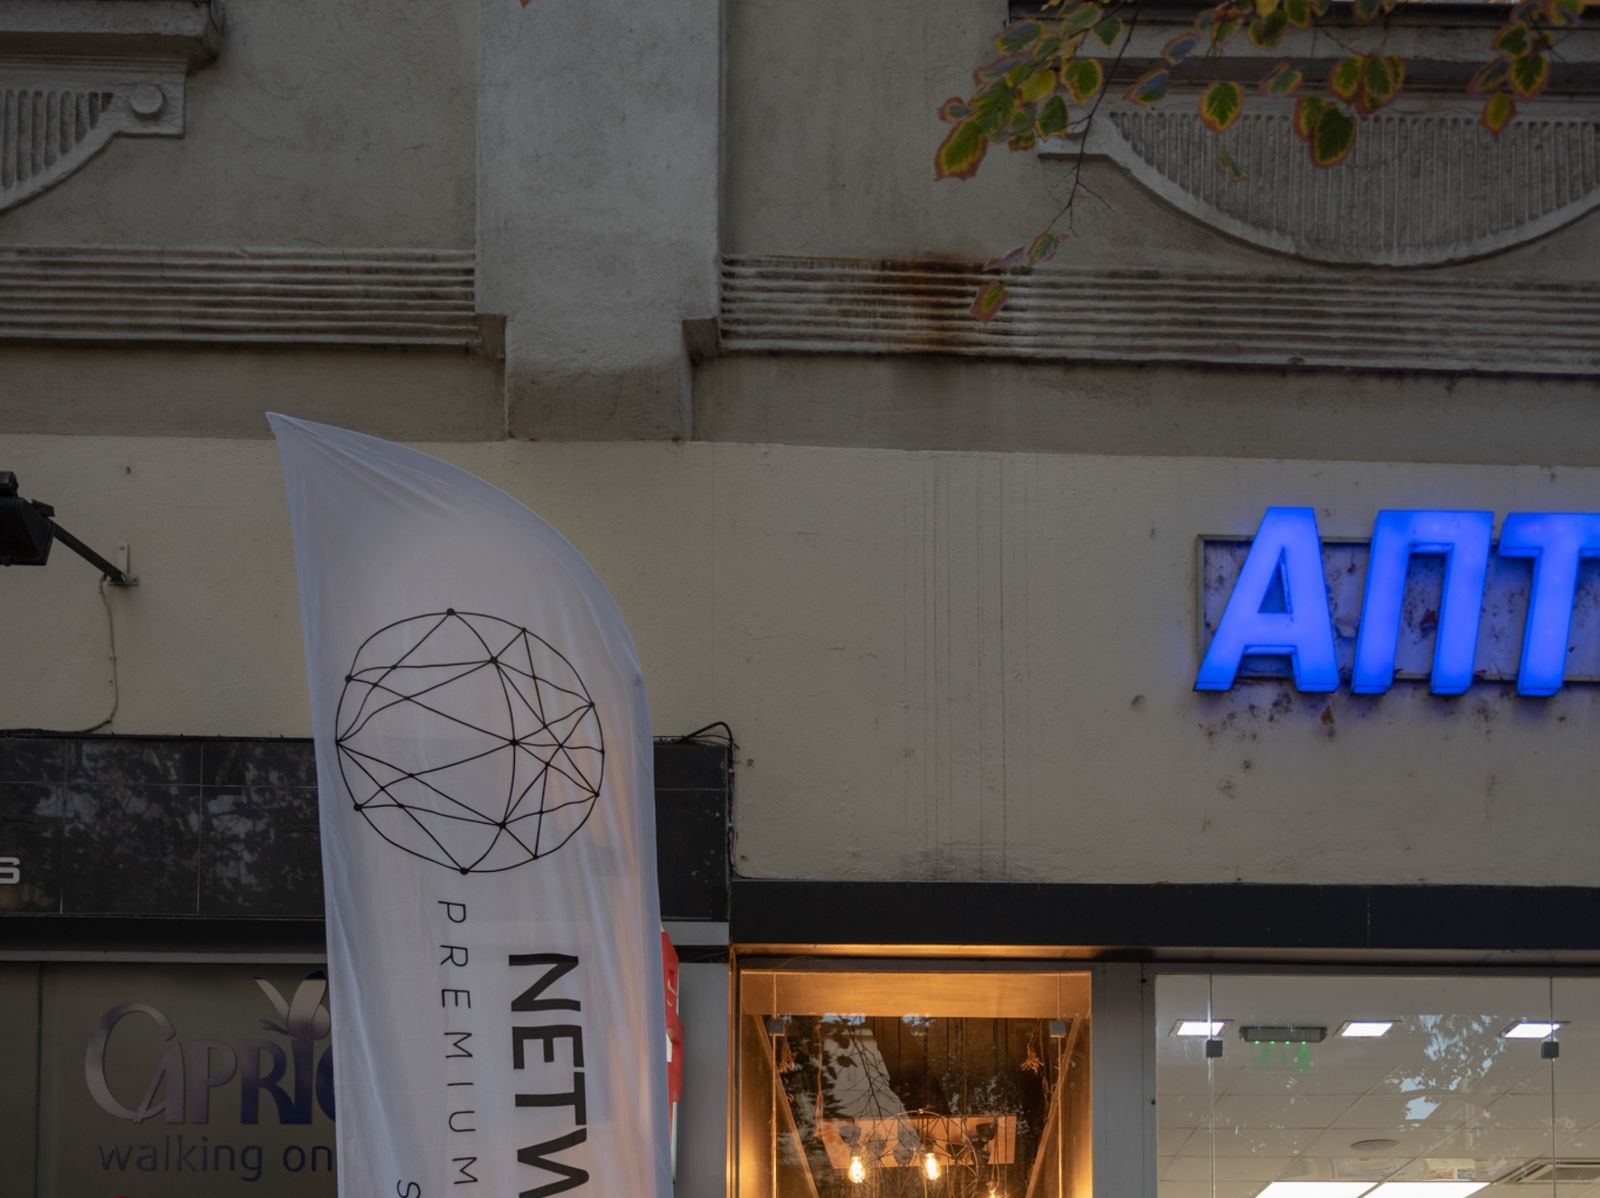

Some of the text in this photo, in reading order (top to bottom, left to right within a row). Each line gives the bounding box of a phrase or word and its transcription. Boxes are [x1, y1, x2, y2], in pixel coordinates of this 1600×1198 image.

[1193, 507, 1600, 698] АПТ
[438, 901, 479, 1185] PREMIUM
[98, 1134, 263, 1181] walking
